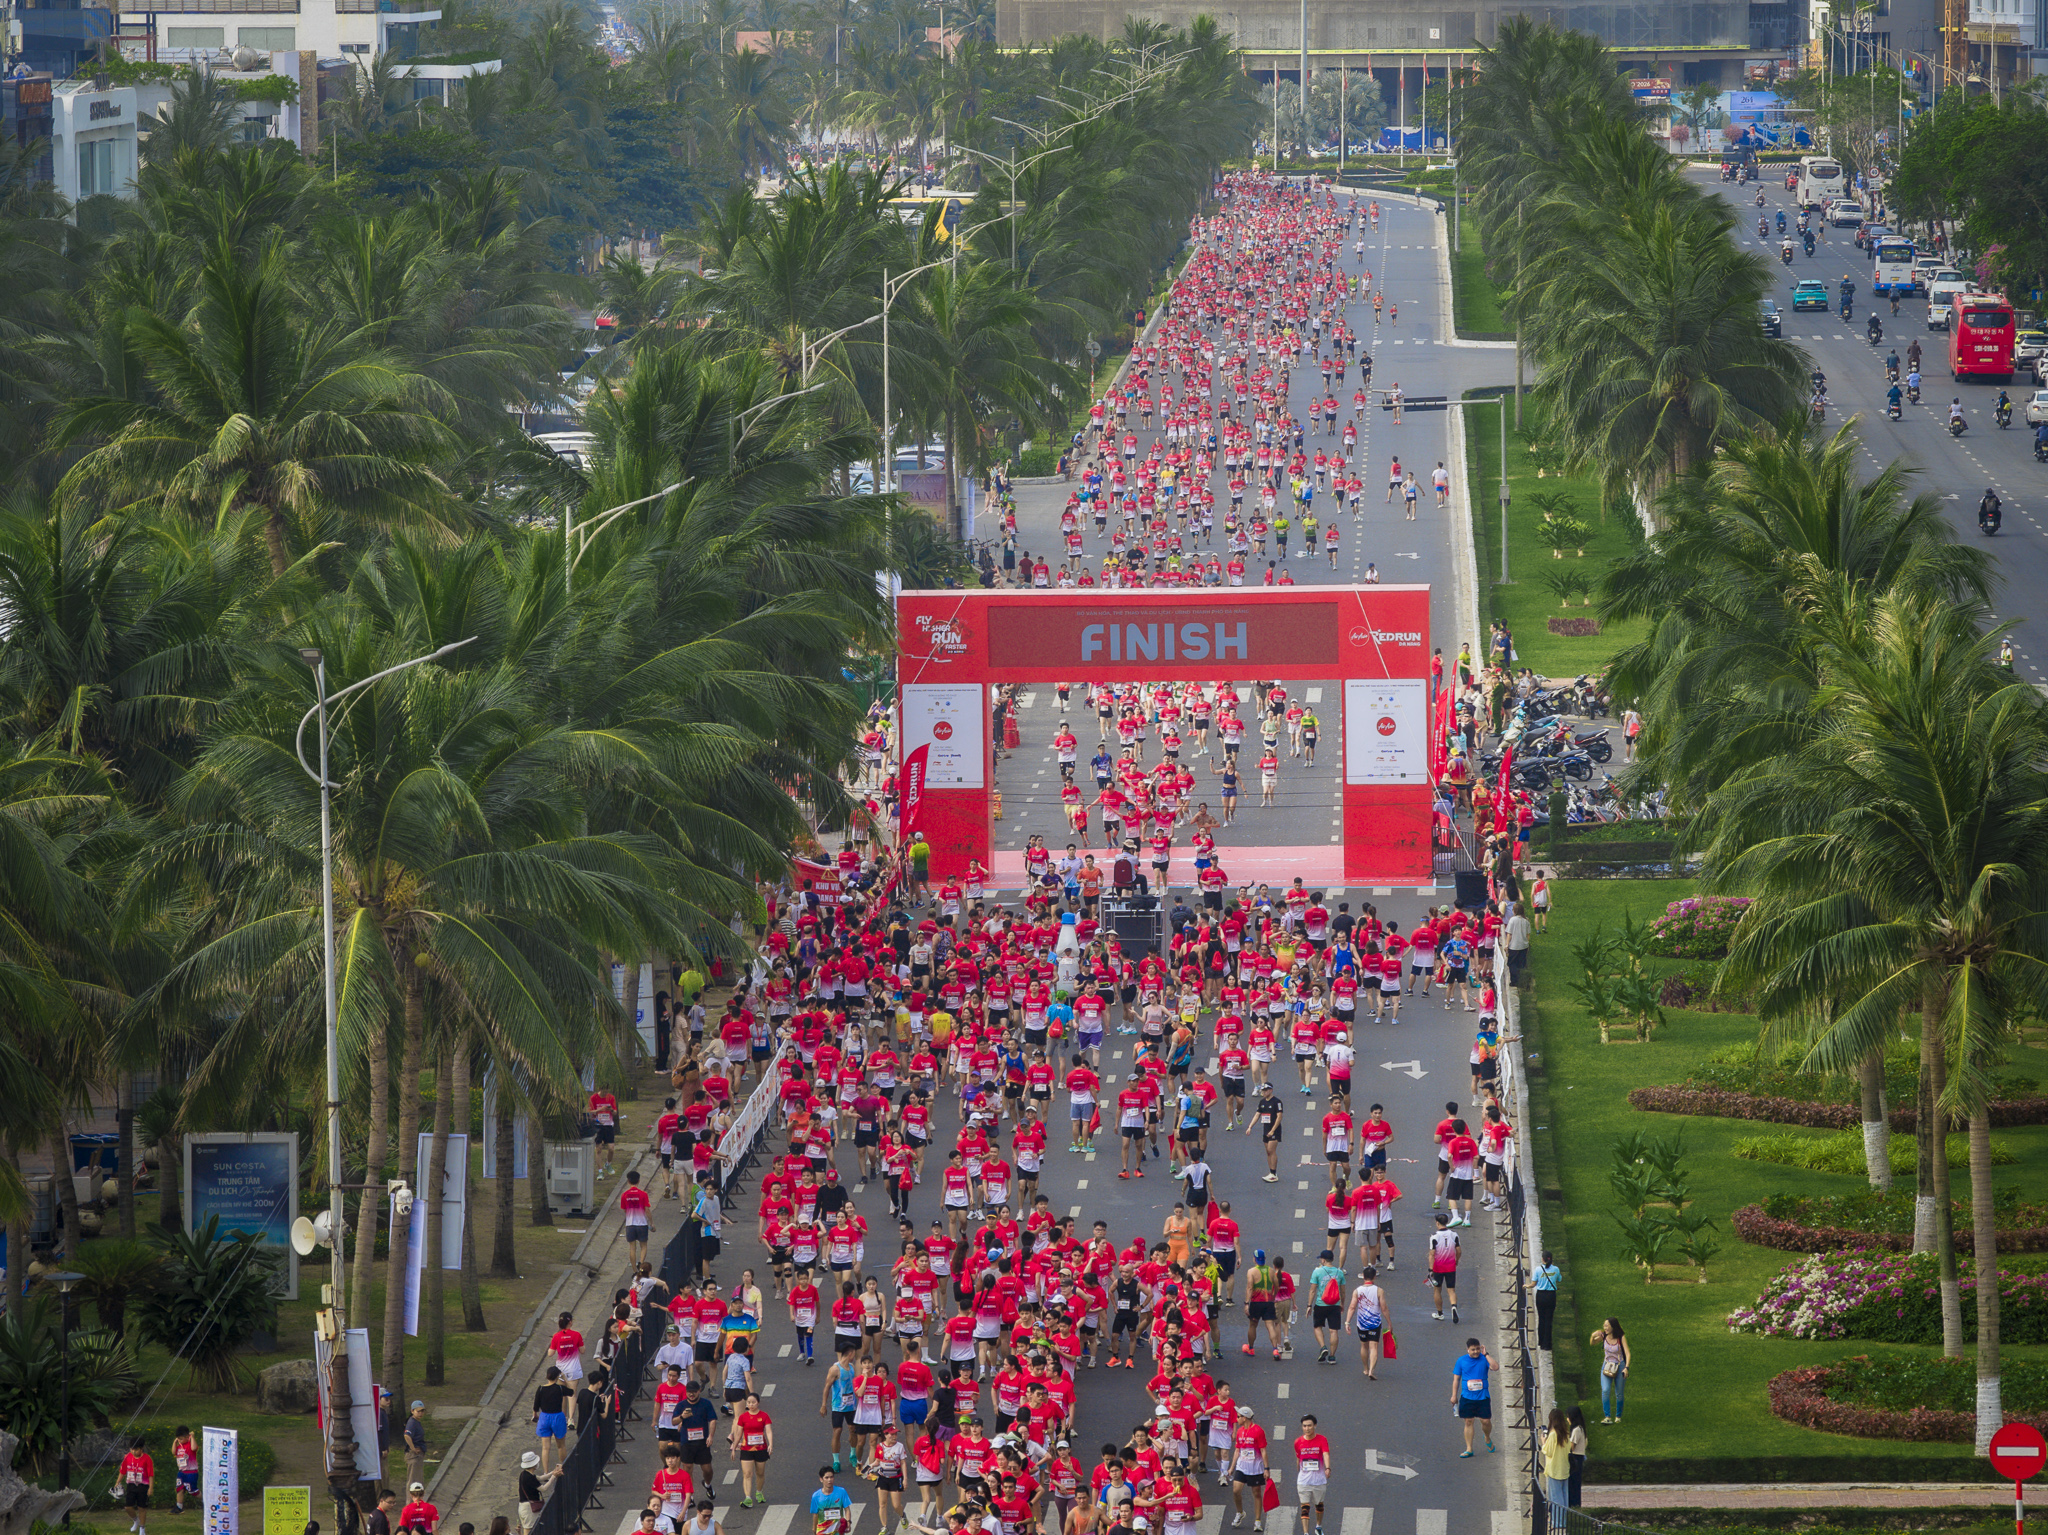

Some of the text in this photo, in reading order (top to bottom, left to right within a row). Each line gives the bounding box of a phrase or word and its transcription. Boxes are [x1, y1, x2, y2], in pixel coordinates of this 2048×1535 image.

[1432, 29, 1436, 37] 2
[916, 616, 932, 625] FLY
[931, 632, 961, 644] RUN
[1081, 622, 1247, 661] FINISH
[1370, 629, 1421, 645] REDRUN
[816, 882, 829, 890] KHU
